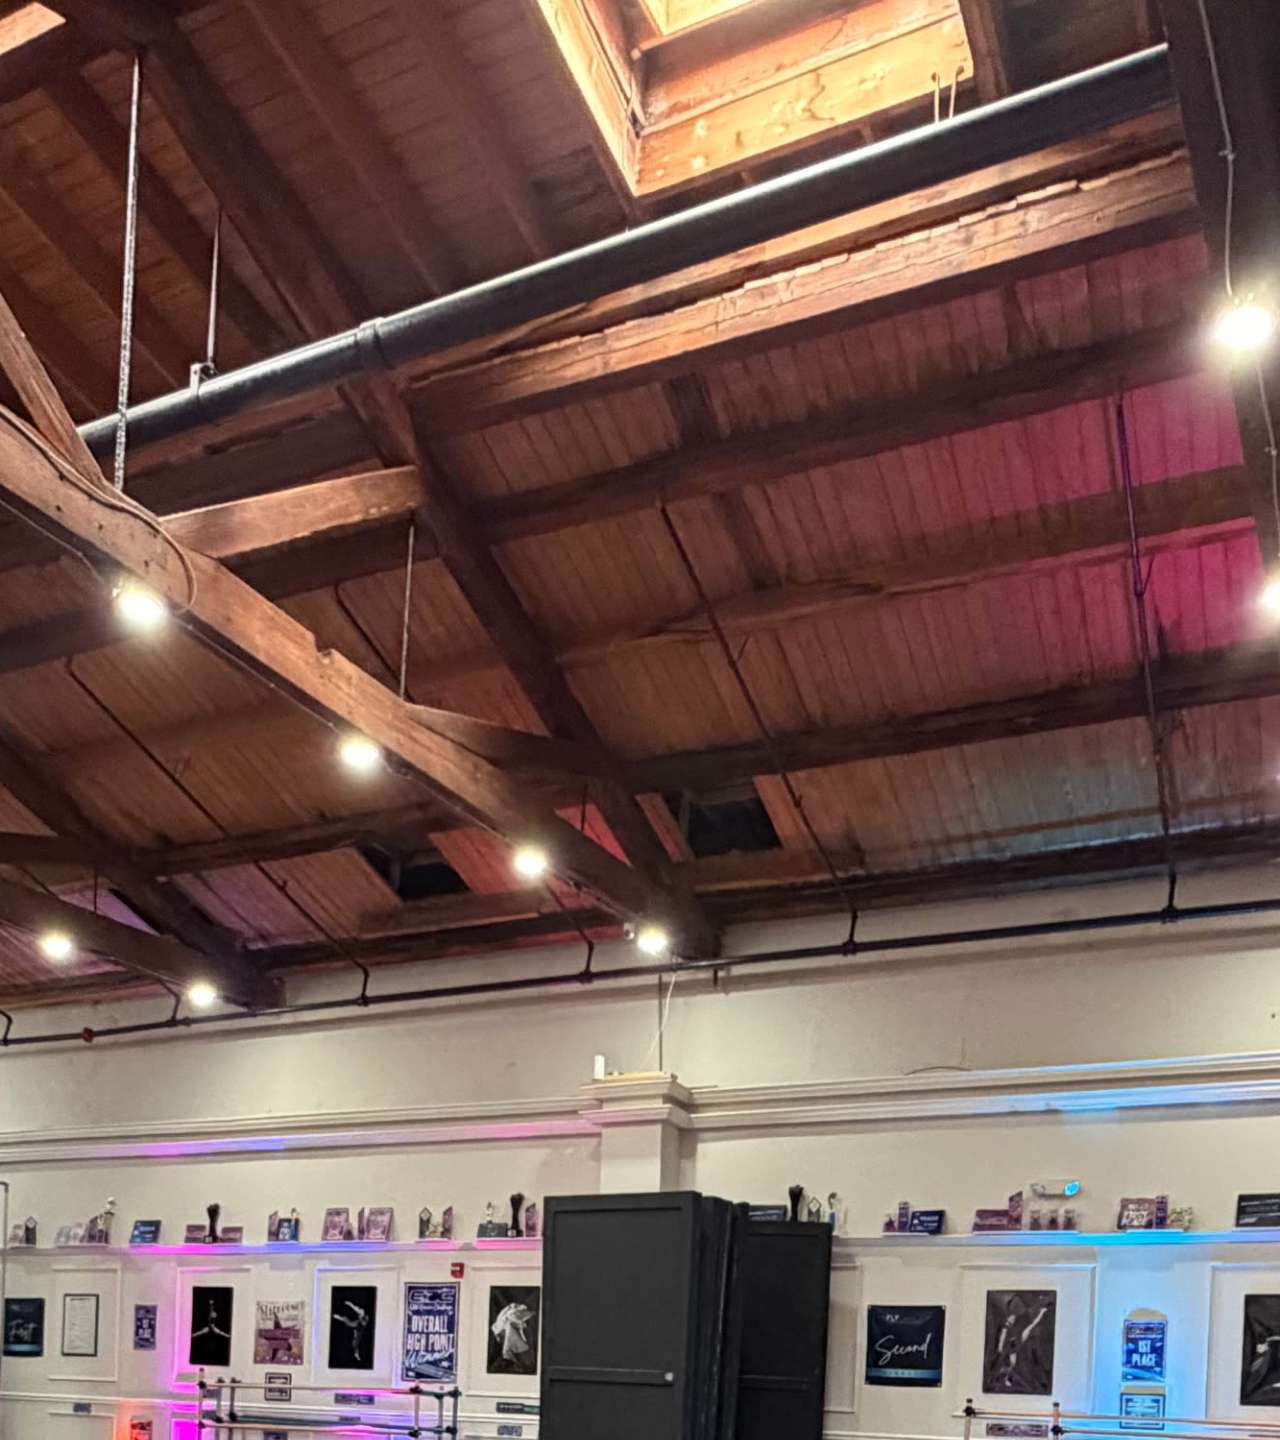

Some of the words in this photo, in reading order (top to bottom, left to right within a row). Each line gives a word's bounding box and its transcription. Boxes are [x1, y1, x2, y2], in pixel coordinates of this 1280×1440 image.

[411, 1314, 448, 1333] OVERALL
[875, 1333, 932, 1366] Second
[1132, 1353, 1157, 1367] PLACE
